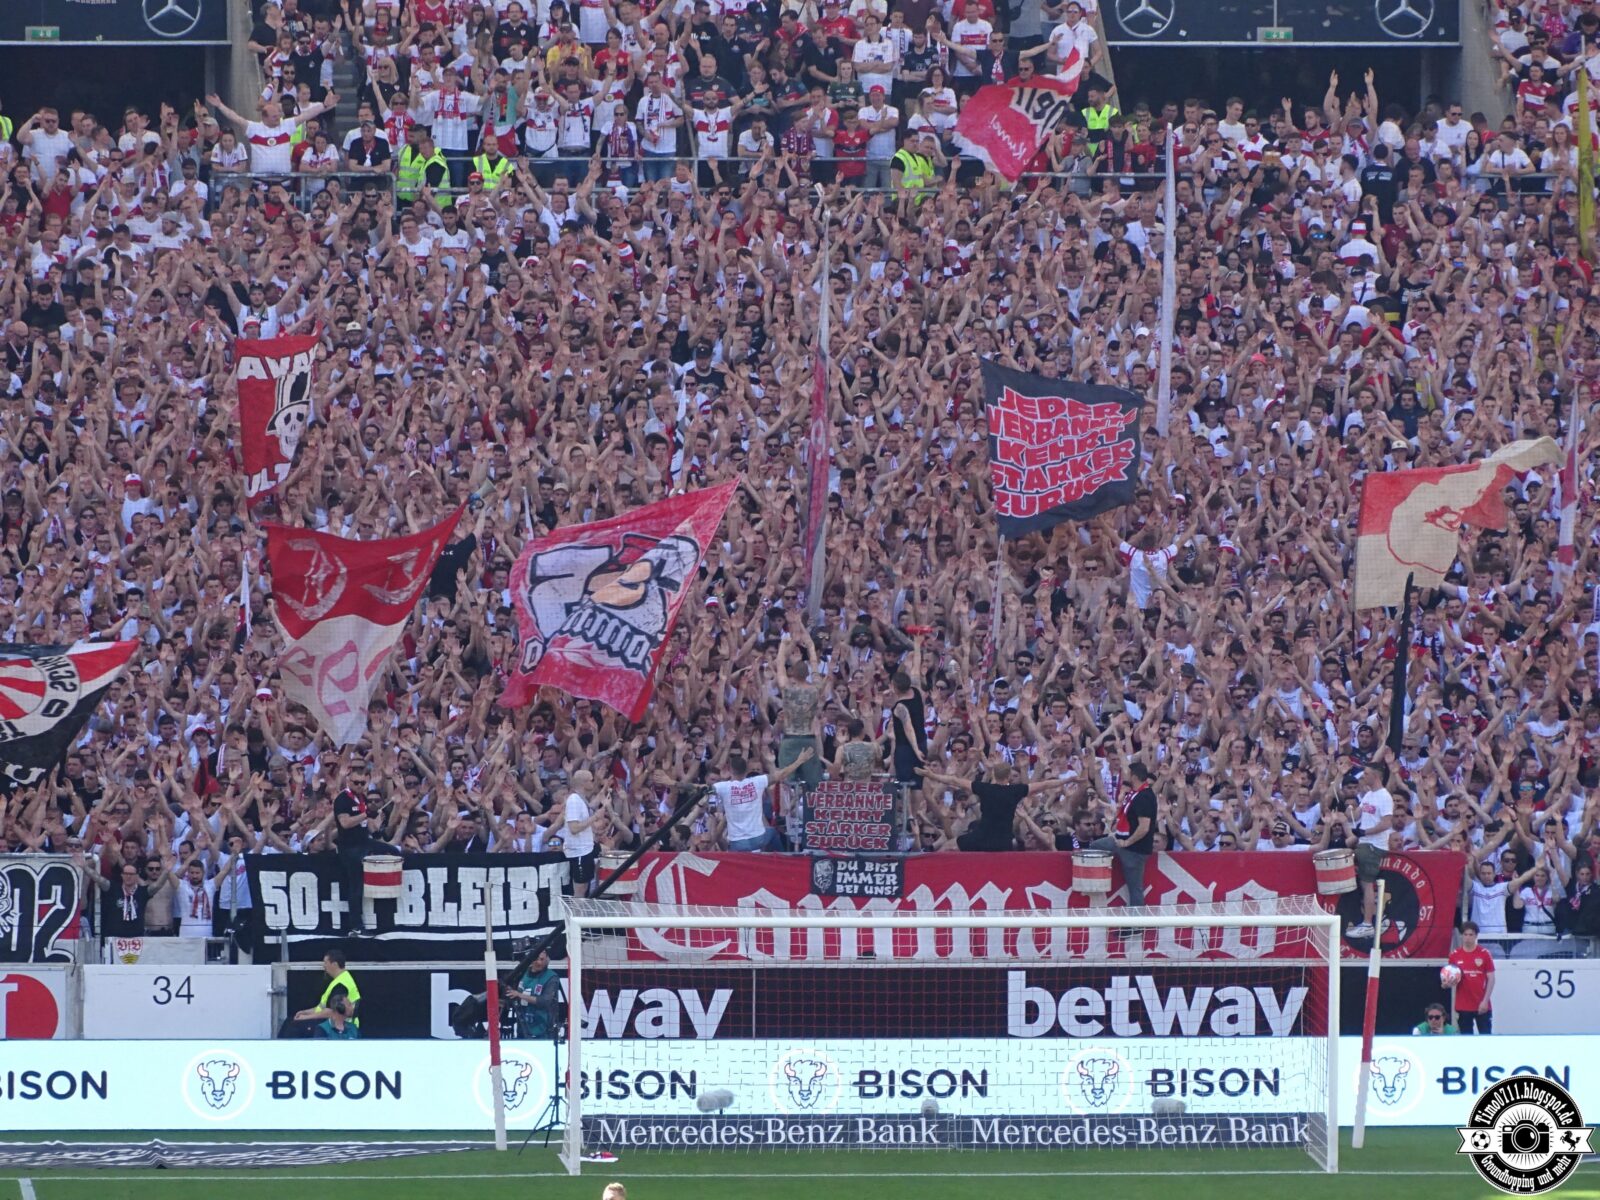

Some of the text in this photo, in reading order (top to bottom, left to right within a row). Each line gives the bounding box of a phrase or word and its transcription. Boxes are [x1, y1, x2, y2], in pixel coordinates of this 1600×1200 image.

[998, 386, 1122, 419] JEDER
[998, 426, 1125, 470] KEHRT
[806, 792, 893, 810] VERBANNTE
[816, 781, 884, 793] JEDER
[814, 809, 885, 822] KEHRT
[836, 860, 899, 873] DU BIST
[836, 872, 898, 886] IMMER
[394, 861, 571, 928] BLEIBT
[835, 884, 899, 896] BEI UNS!
[1419, 905, 1434, 921] 97
[152, 976, 195, 1006] 34
[1533, 969, 1576, 999] 35
[1008, 970, 1309, 1037] betway
[0, 1070, 108, 1100] ISON
[266, 1070, 402, 1100] BISON
[853, 1069, 988, 1099] BISON
[1145, 1067, 1280, 1097] BISON
[598, 1117, 941, 1145] Mercedes-Benz Bank
[970, 1116, 1313, 1145] Mercedes-Benz Bank
